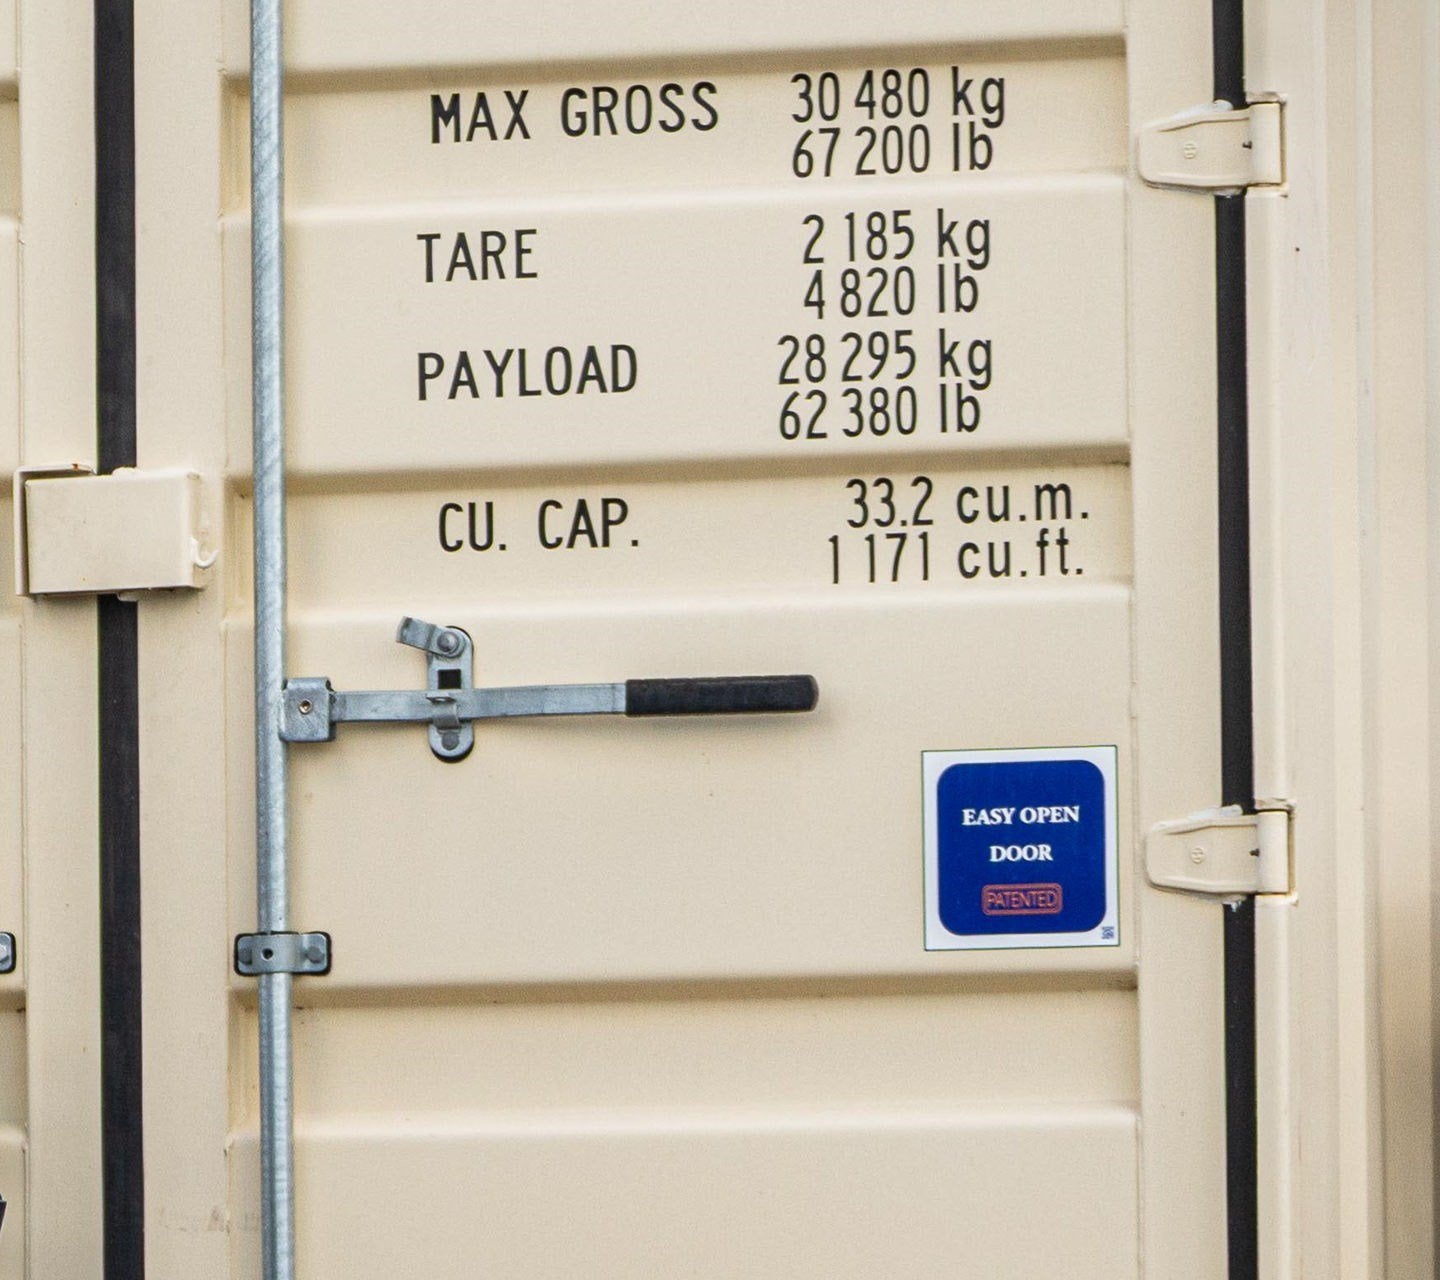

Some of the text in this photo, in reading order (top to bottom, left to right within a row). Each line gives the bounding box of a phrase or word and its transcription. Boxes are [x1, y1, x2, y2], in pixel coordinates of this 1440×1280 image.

[431, 66, 1005, 143] MAX GROSS 30 480 kg
[793, 122, 994, 177] 67 200 lb
[417, 229, 537, 282] TARE
[845, 210, 914, 261] 185
[938, 208, 991, 270] kg
[841, 266, 915, 317] 820
[939, 263, 980, 313] lb
[418, 329, 992, 400] PAYLOAD 28 295 kg
[780, 383, 982, 440] 62 380 lb
[439, 502, 506, 552] CU.
[539, 498, 638, 549] CAP.
[847, 476, 933, 528] 33.2
[962, 805, 1080, 825] EASY OPEN
[989, 844, 1053, 862] DOOR
[987, 890, 1057, 908] PATENTED
